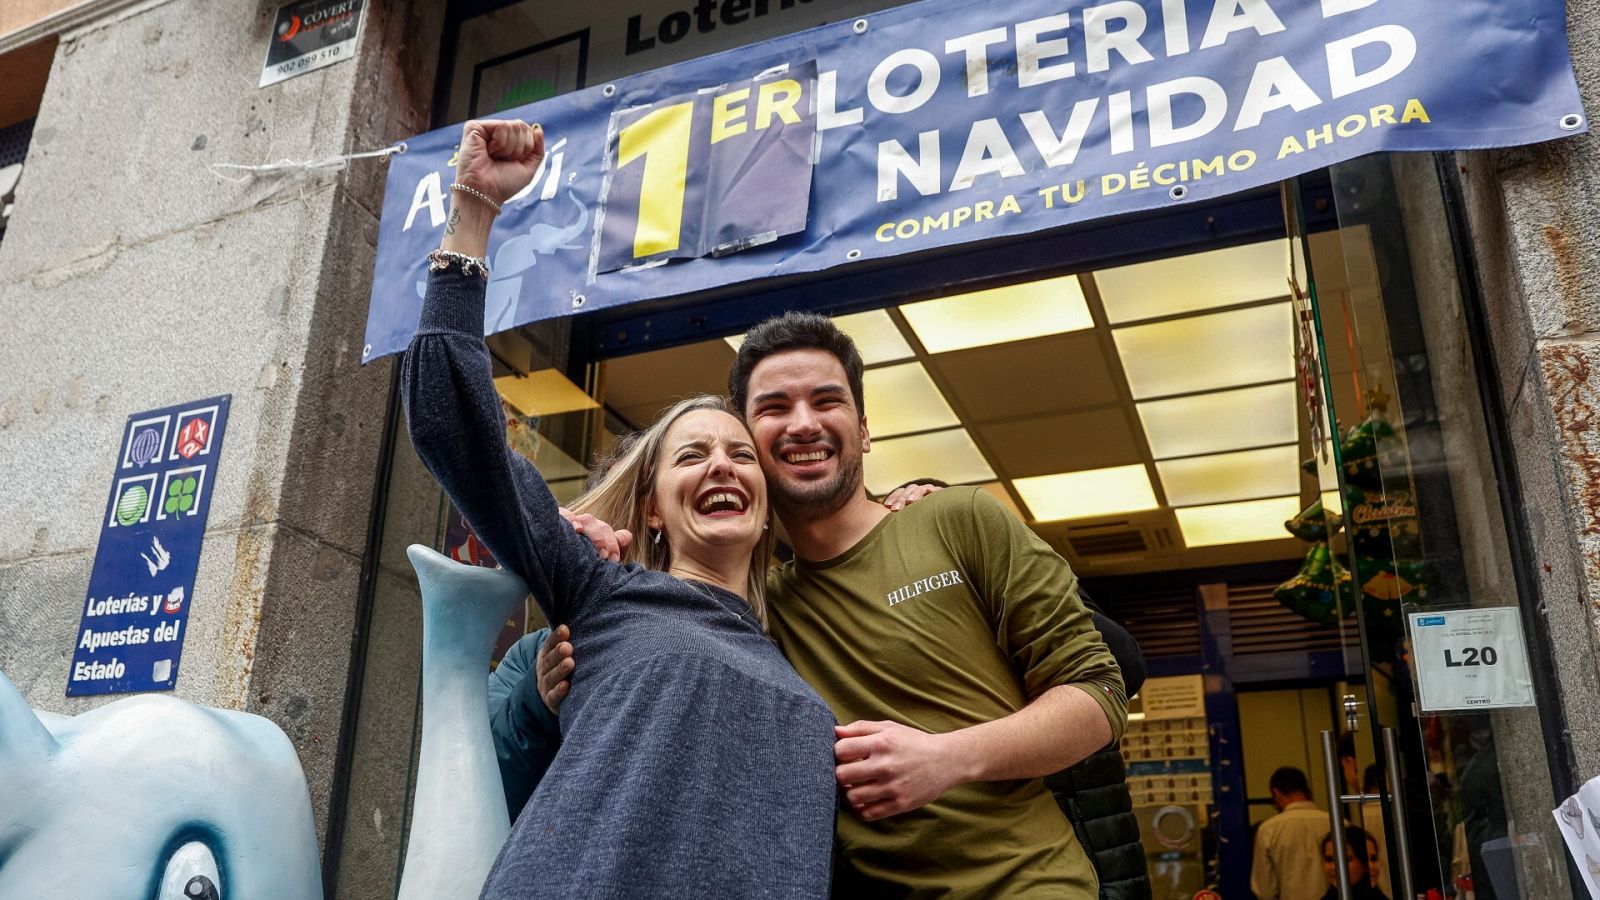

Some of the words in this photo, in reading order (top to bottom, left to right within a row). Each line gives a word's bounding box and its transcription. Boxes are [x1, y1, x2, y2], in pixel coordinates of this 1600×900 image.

[304, 1, 353, 25] COVERT
[277, 61, 295, 74] 902
[876, 24, 1418, 203] NAVIDAD
[875, 194, 1022, 243] COMPRA
[1039, 179, 1086, 209] TU
[1101, 149, 1258, 197] DÉCIMO
[1276, 98, 1431, 160] AHORA
[886, 569, 964, 607] HILFIGER
[86, 592, 149, 617] Loterías
[150, 594, 163, 616] y
[79, 624, 150, 653] Apuestas
[153, 620, 180, 643] del
[73, 658, 126, 681] Estado
[1443, 646, 1498, 668] L20
